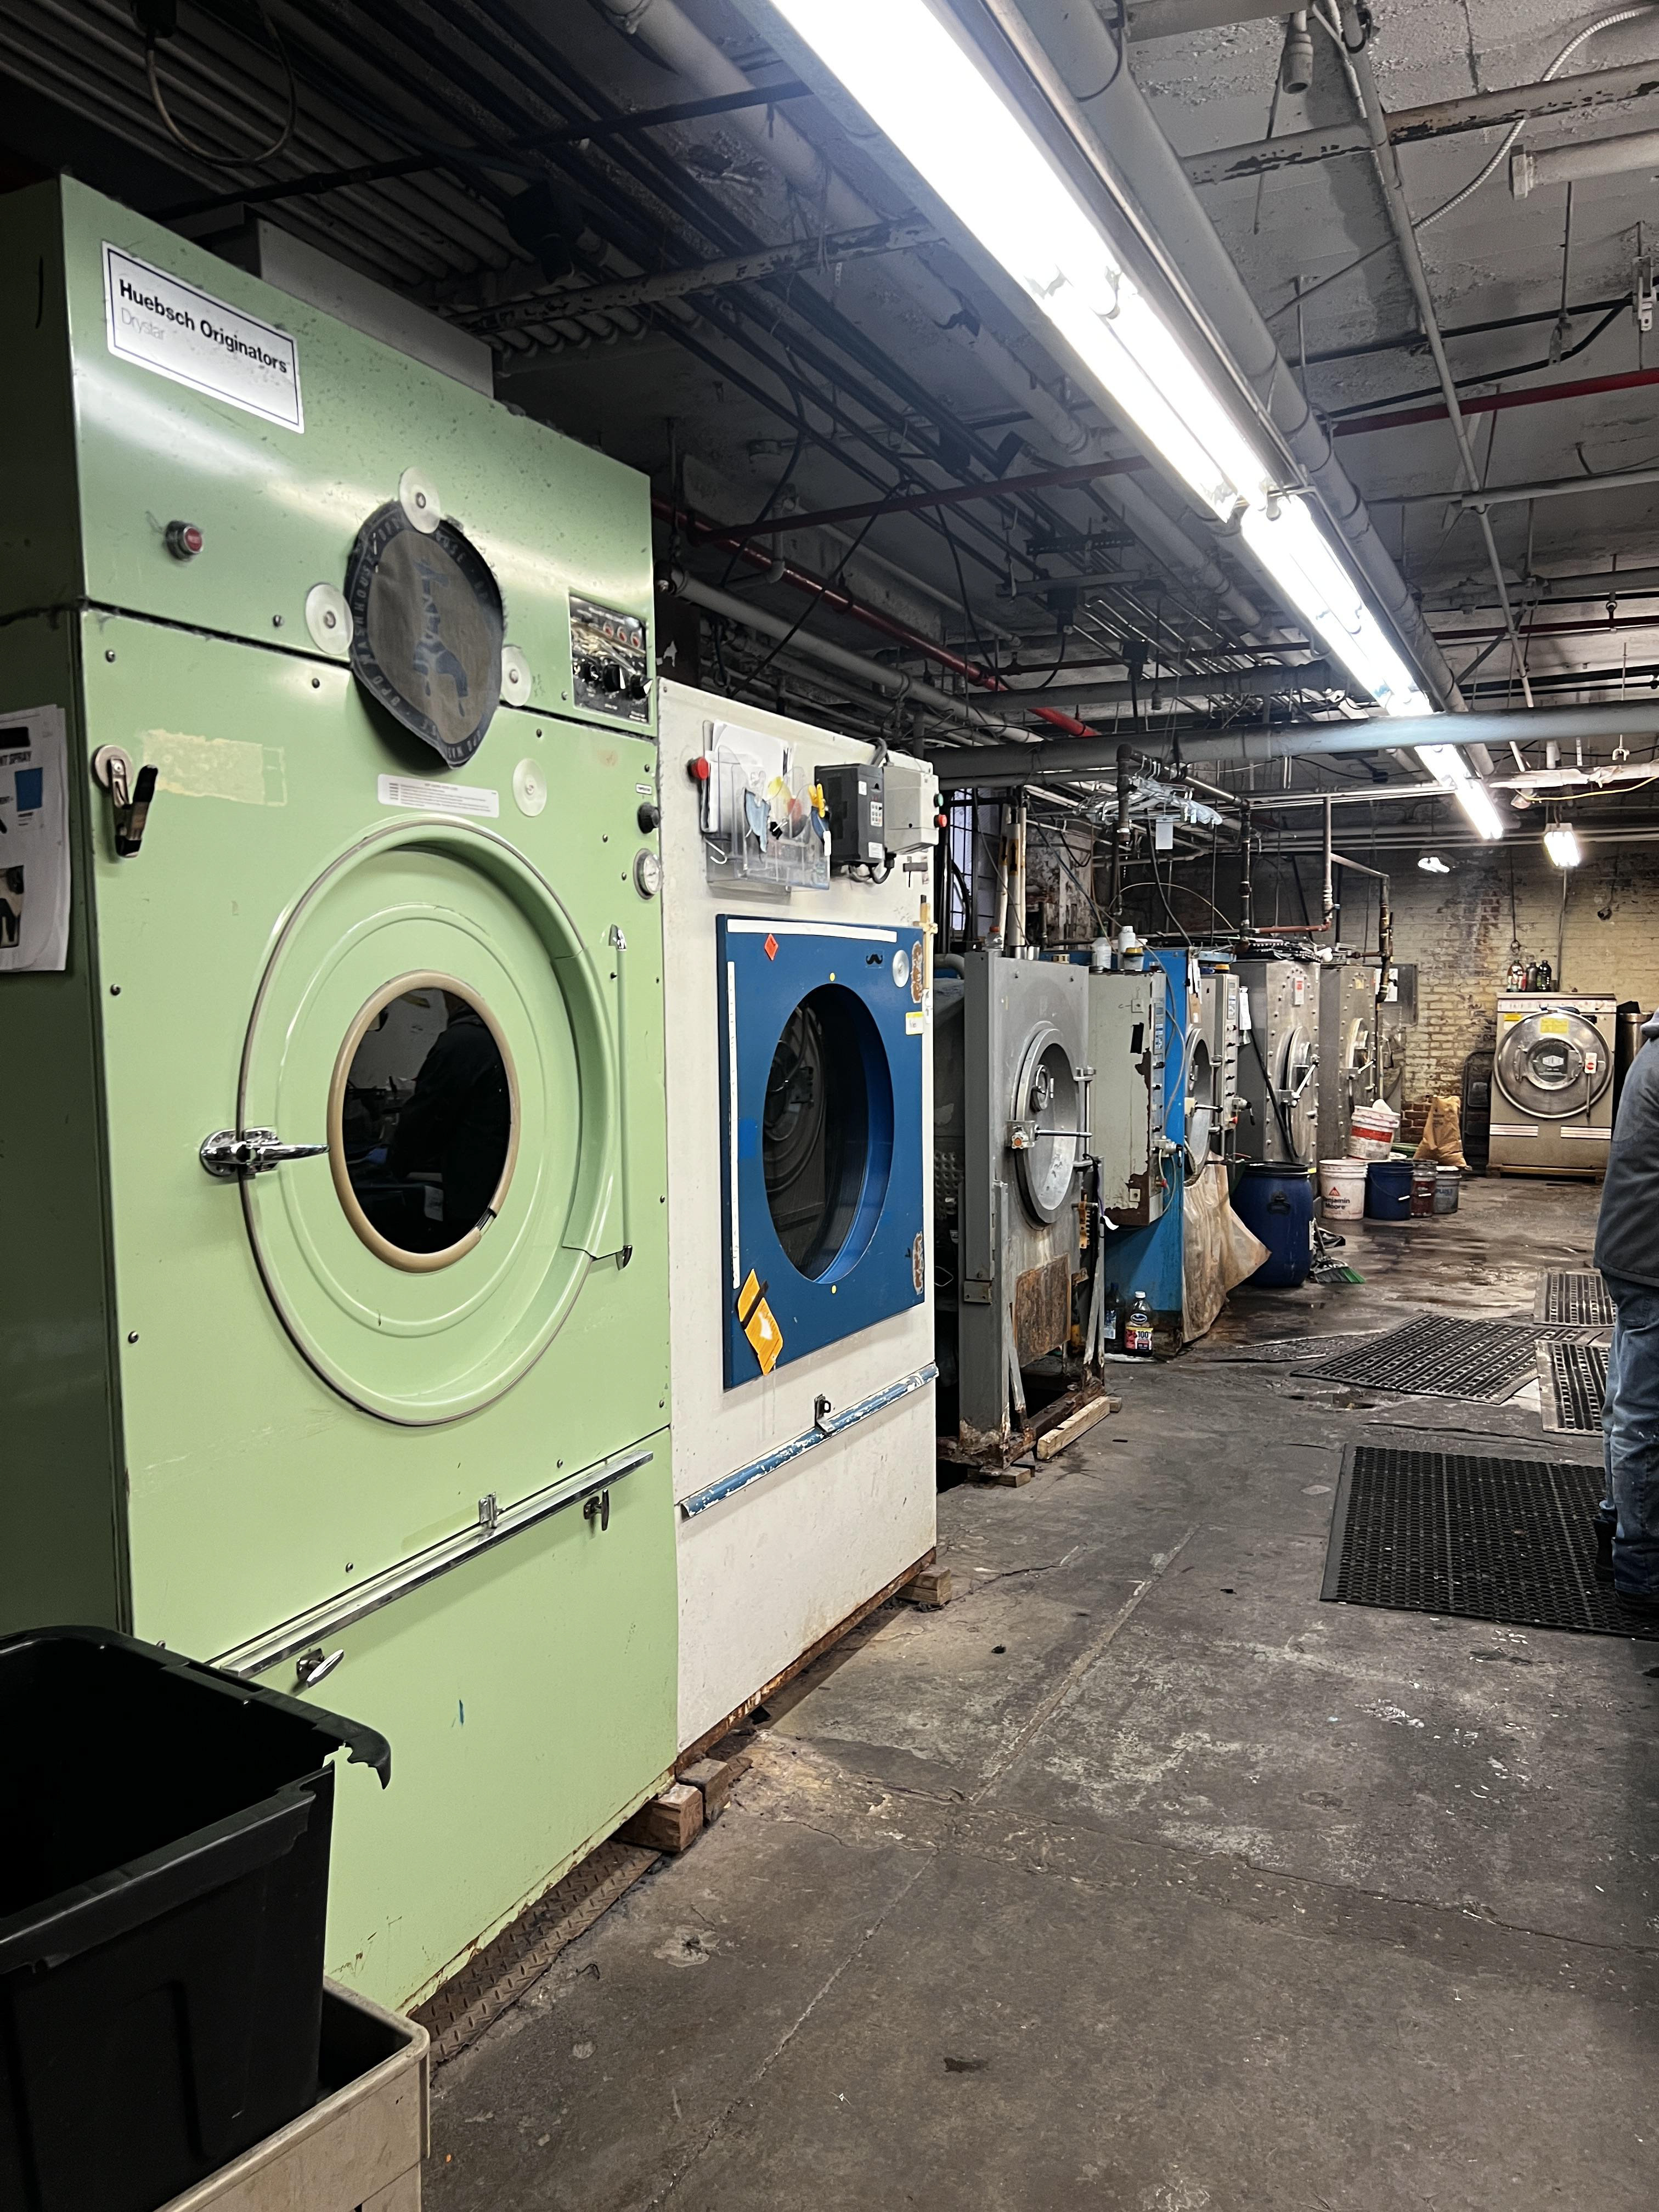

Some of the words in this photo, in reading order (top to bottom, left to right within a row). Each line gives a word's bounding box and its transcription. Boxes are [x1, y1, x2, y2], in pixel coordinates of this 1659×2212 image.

[119, 279, 195, 331] Huebsch
[200, 320, 287, 374] Originators
[121, 307, 165, 340] Drystar
[1137, 1330, 1149, 1339] 100
